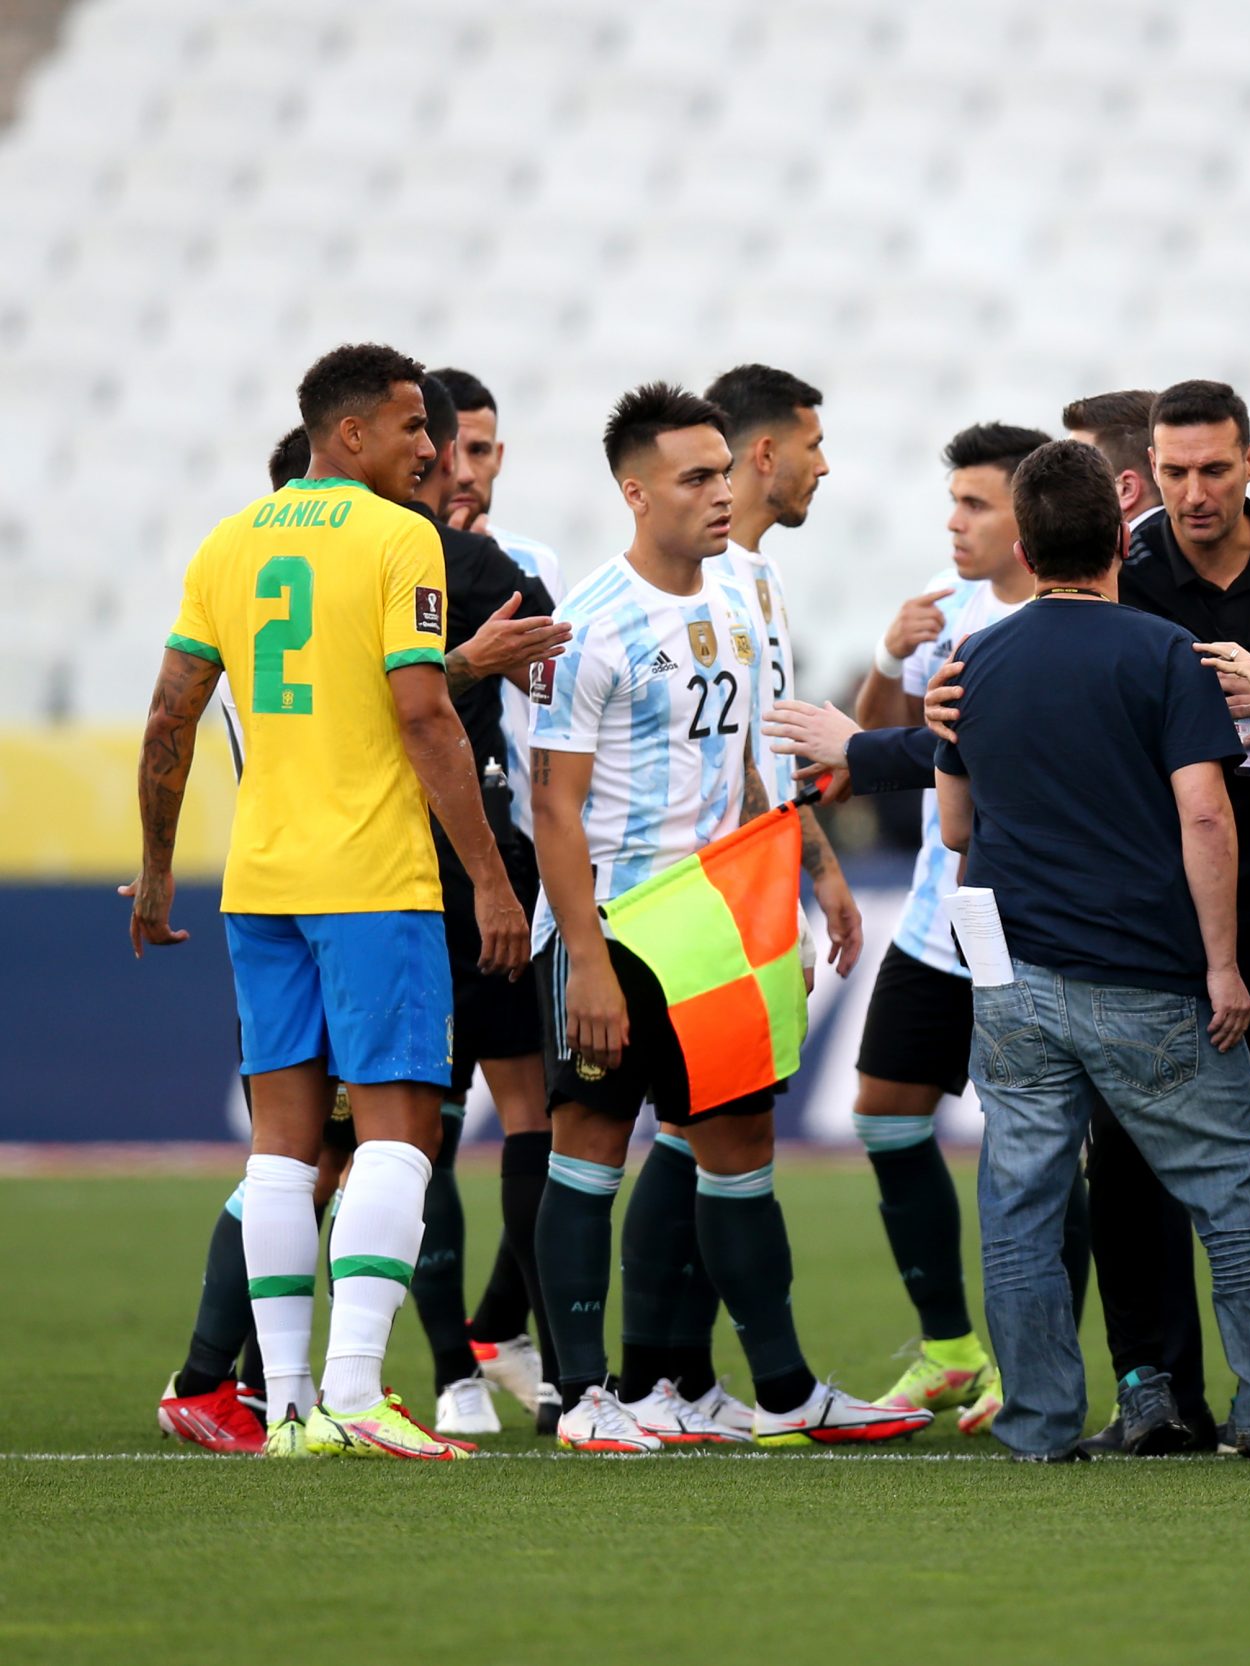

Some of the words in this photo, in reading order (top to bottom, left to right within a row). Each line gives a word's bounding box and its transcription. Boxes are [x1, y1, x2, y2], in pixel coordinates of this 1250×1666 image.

[252, 500, 352, 528] DANILO
[252, 556, 314, 714] 2
[651, 661, 679, 675] adidas
[686, 670, 739, 740] 22
[571, 1300, 601, 1312] AFA
